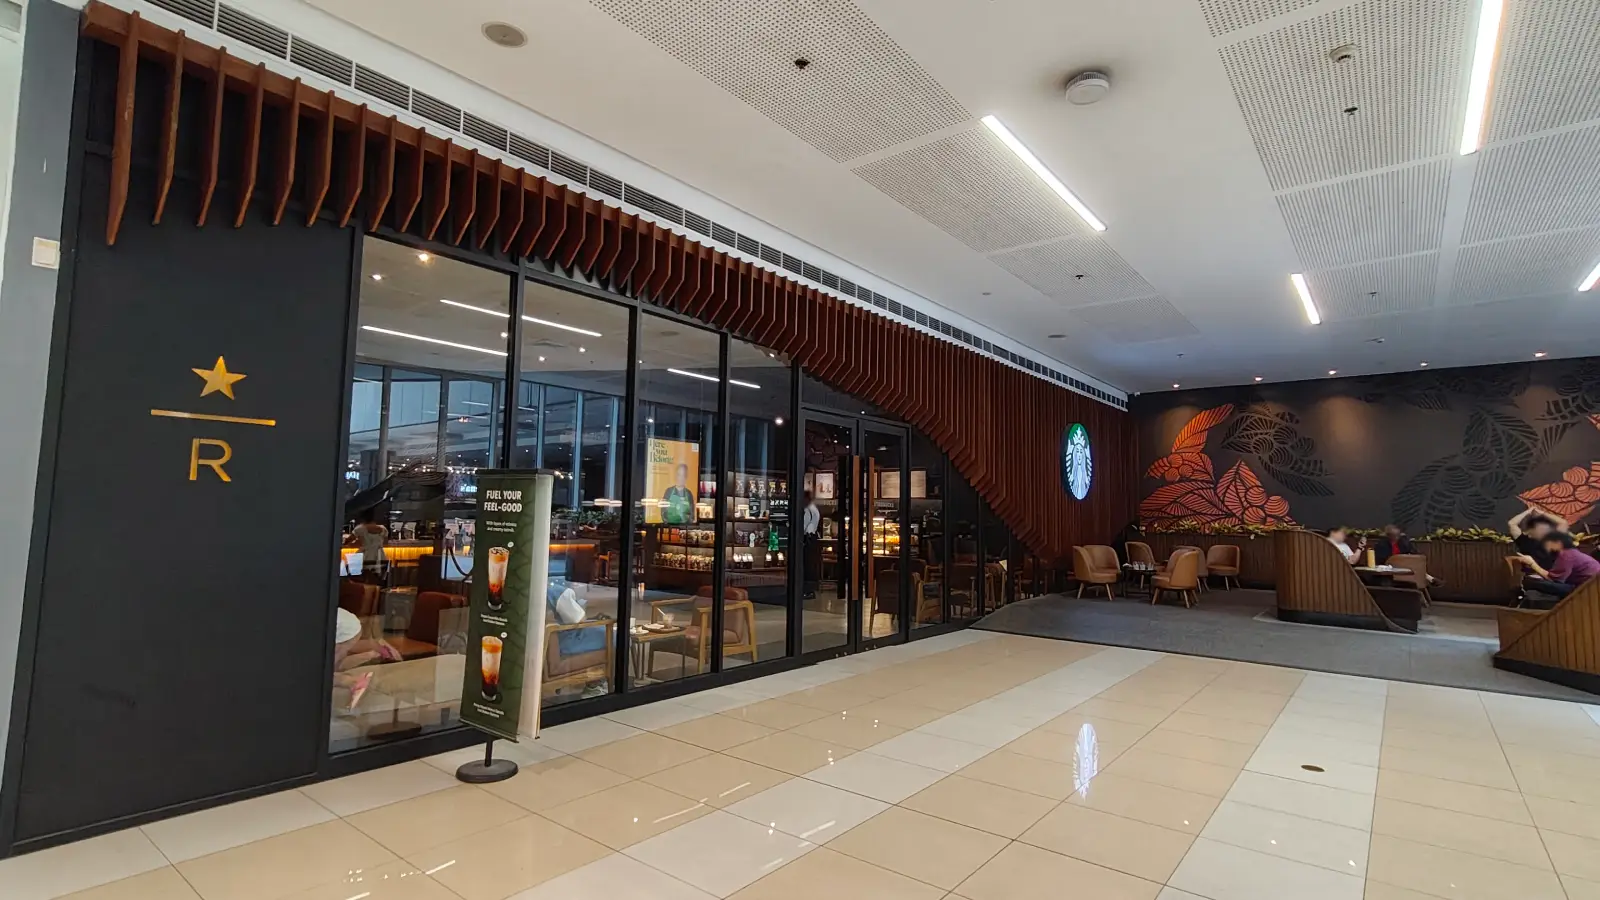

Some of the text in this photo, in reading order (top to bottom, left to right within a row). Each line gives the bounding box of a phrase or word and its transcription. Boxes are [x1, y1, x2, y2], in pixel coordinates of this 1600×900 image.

[189, 437, 233, 482] R
[486, 490, 522, 501] FUEL YOUR
[483, 501, 523, 513] FEEL-GOOD
